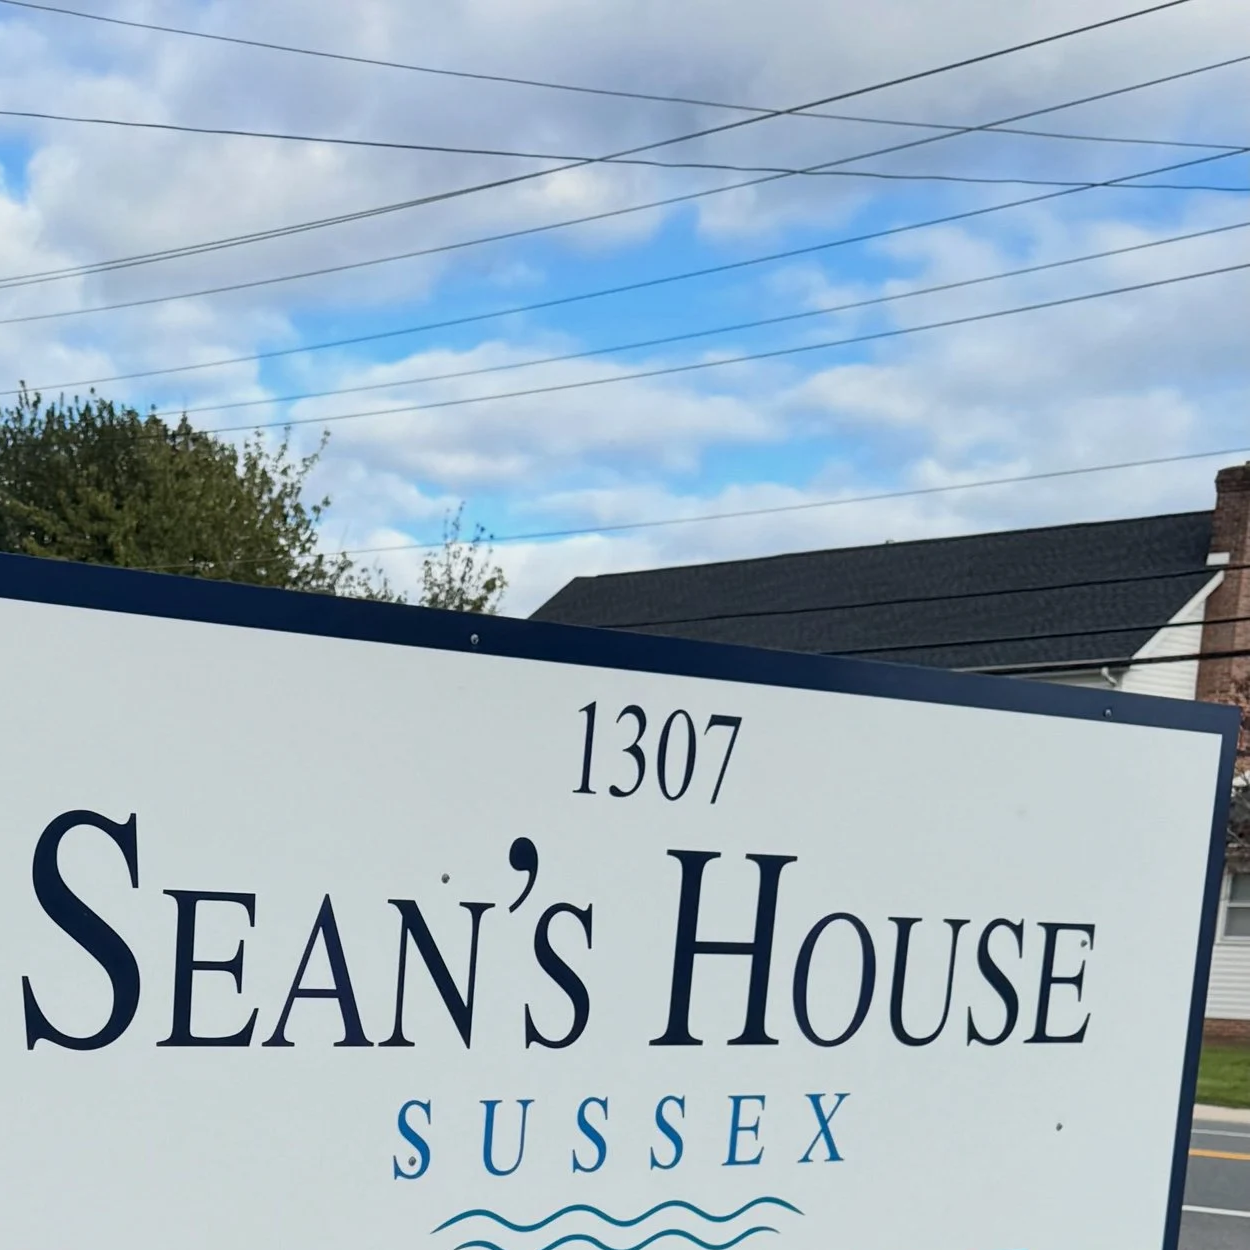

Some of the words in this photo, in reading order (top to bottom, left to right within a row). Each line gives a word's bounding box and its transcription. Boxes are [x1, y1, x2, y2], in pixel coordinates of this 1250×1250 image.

[572, 700, 743, 805] 1307
[648, 848, 1096, 1048] HOUSE
[393, 1092, 851, 1181] SUSSEX
